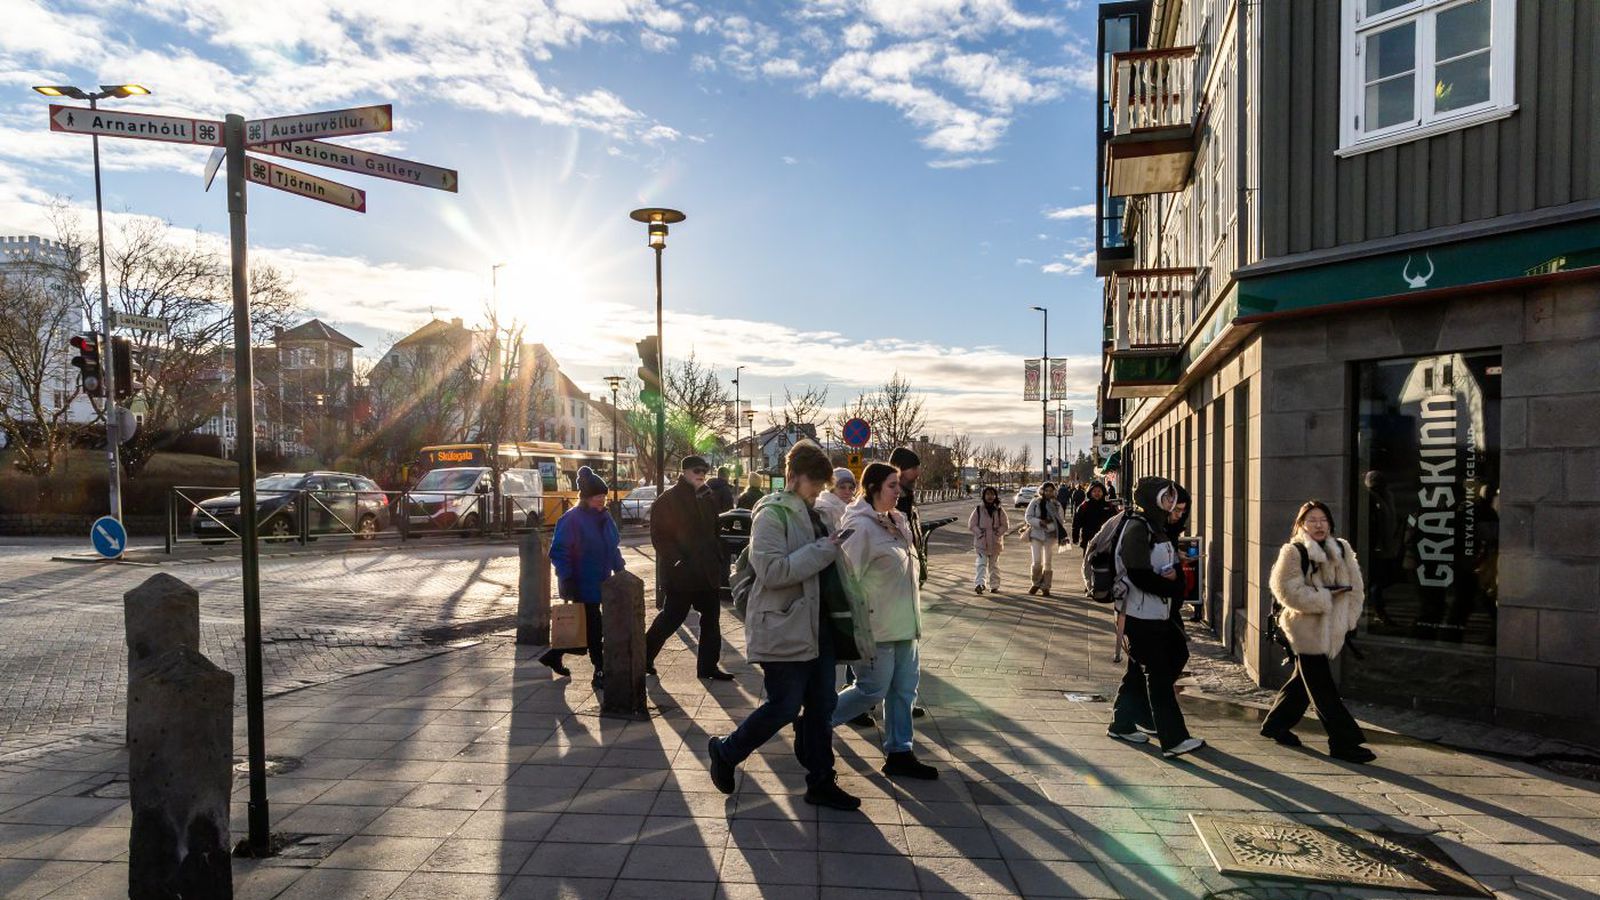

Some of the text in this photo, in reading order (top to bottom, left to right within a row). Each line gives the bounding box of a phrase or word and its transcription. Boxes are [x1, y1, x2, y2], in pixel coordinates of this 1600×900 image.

[92, 116, 186, 137] Arnarhóll
[271, 114, 365, 137] Austurvöllur
[281, 141, 421, 181] National Gallery
[276, 171, 325, 196] Tjörnin
[1465, 428, 1476, 556] REYKJAVIK ICELAND
